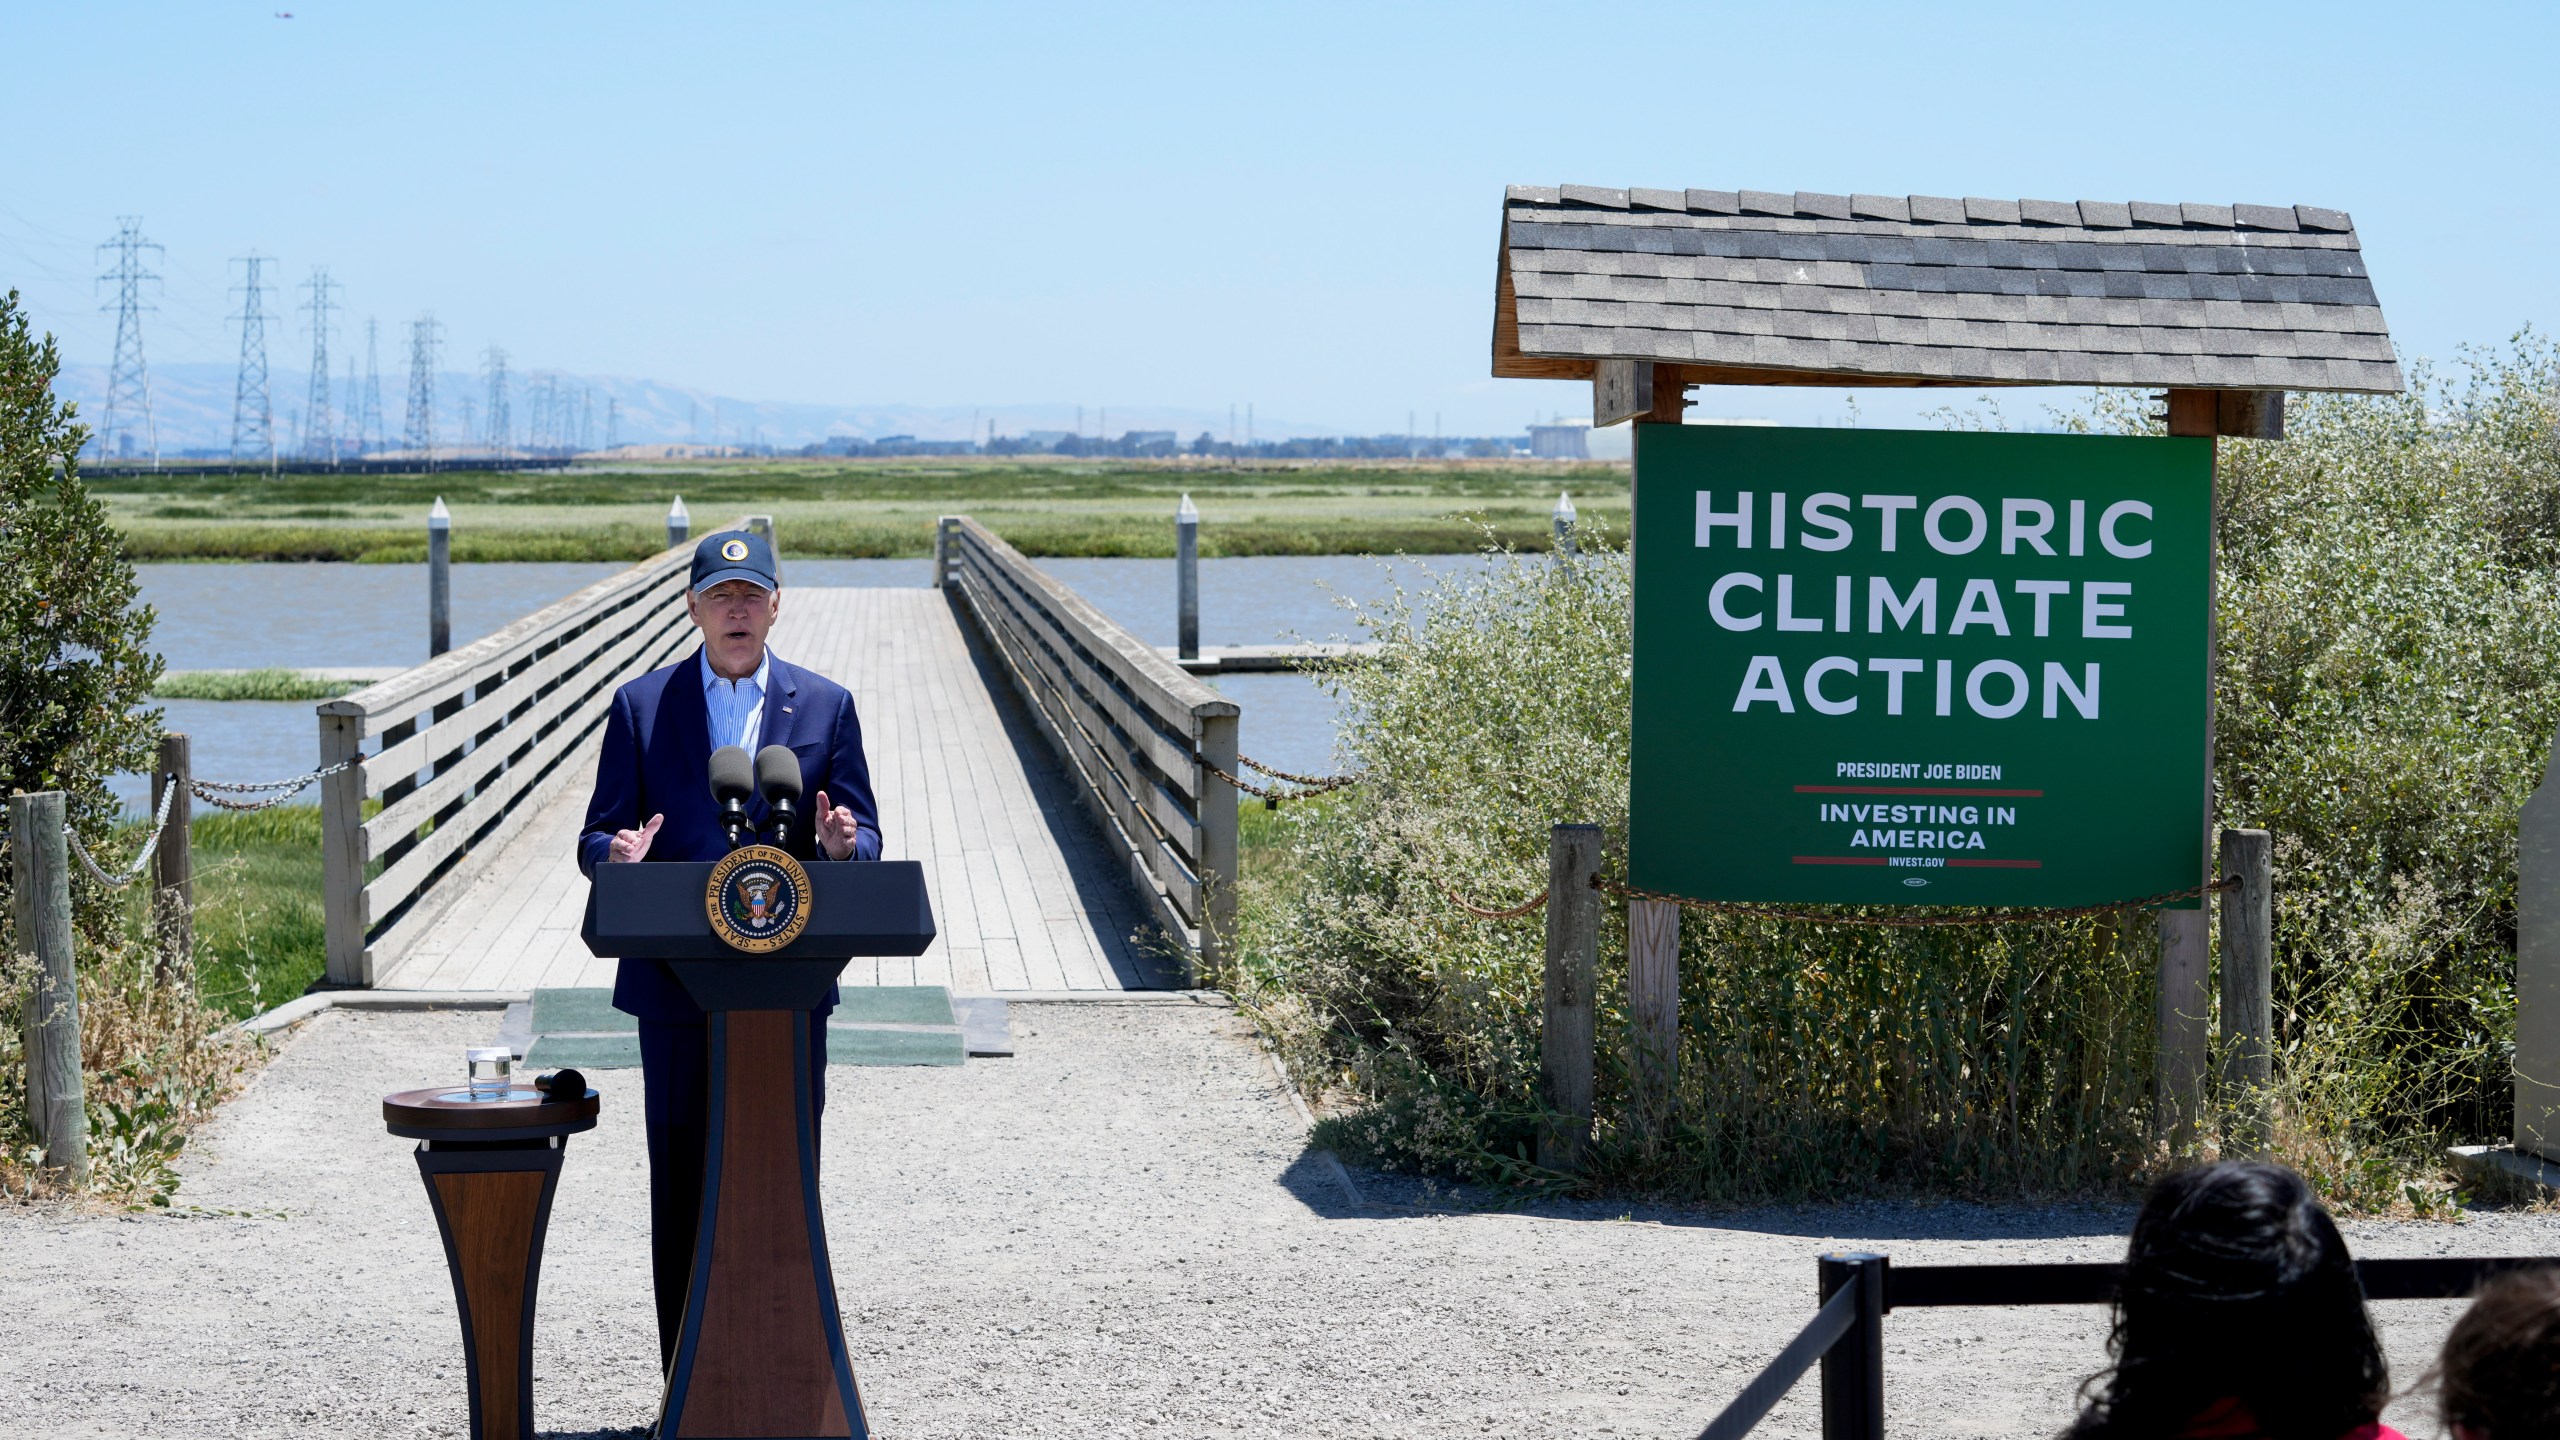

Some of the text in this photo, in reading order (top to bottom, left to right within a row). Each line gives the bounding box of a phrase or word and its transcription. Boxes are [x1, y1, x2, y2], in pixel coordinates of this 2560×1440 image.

[1694, 490, 2153, 559] HISTORIC
[1708, 572, 2133, 639] CLIMATE
[1732, 655, 2100, 719] ACTION
[1837, 762, 2001, 780] PRESIDENT JOE BIDEN
[1820, 803, 2015, 826] INVESTING IN
[1850, 829, 1986, 850] AMERICA
[770, 852, 783, 863] THE
[1889, 857, 1945, 868] INVEST.GOV
[709, 850, 755, 898] PRESIDENT
[786, 861, 809, 904] UNITED
[715, 919, 723, 927] OF
[769, 914, 804, 947] STATES
[723, 926, 750, 947] SEAL
